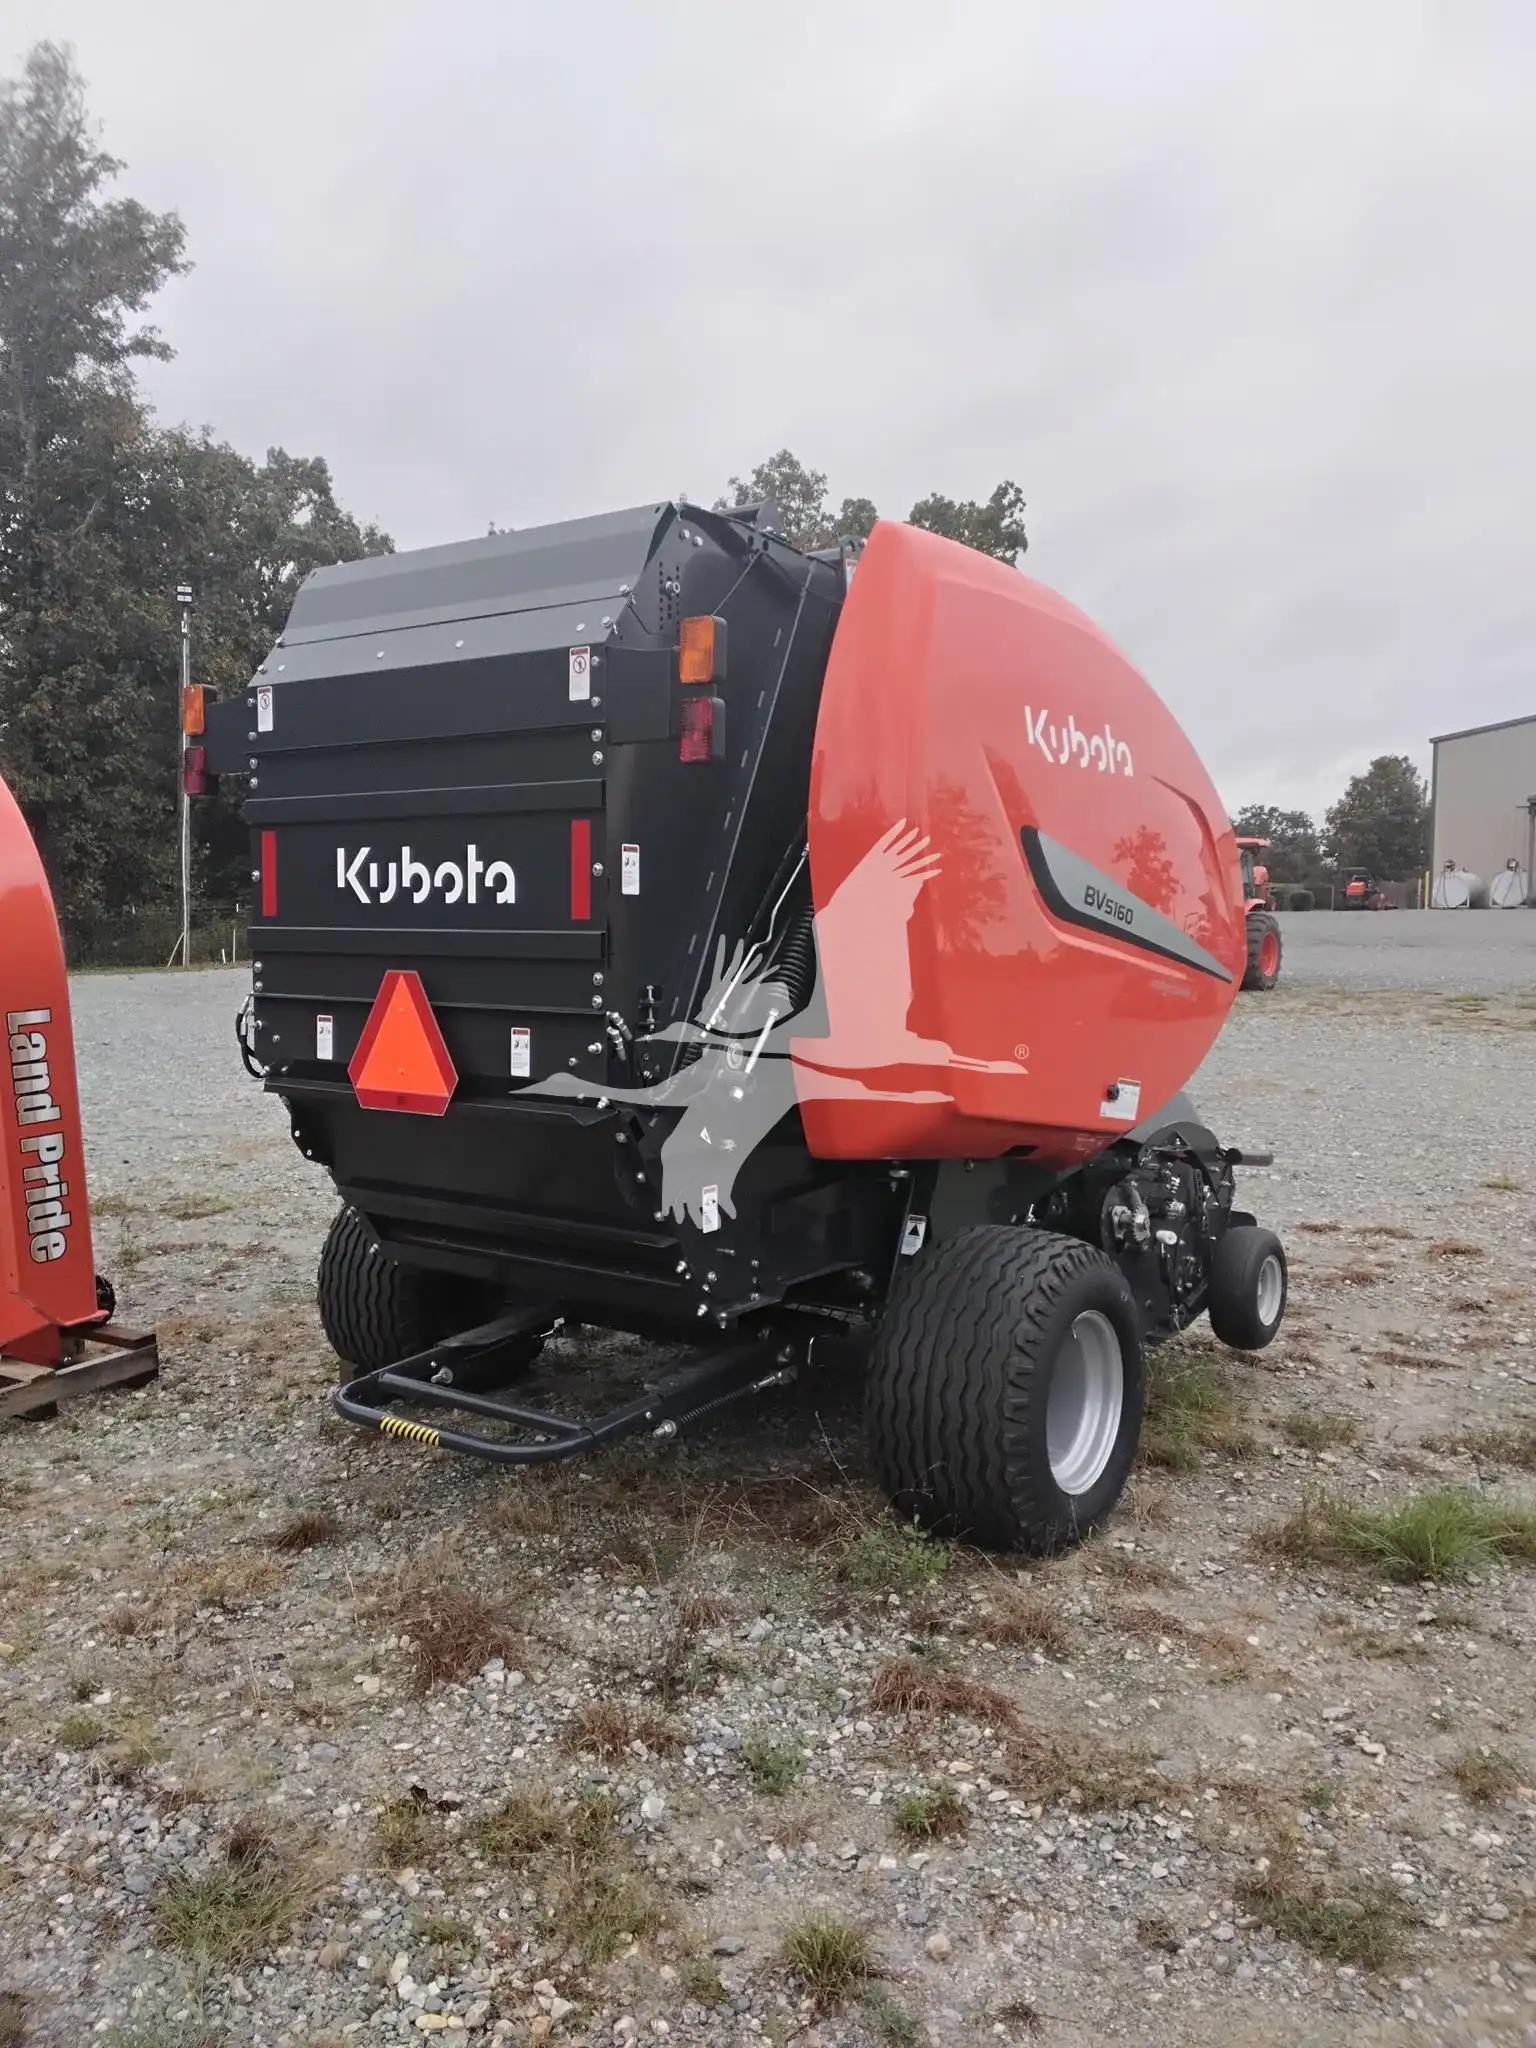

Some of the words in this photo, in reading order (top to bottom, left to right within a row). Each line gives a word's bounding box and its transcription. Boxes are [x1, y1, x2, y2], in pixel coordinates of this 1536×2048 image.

[1024, 705, 1134, 777] Kubota
[336, 844, 516, 904] Kubota
[1084, 884, 1134, 925] BV5160
[6, 1008, 62, 1126] Land
[20, 1132, 72, 1263] Pride
